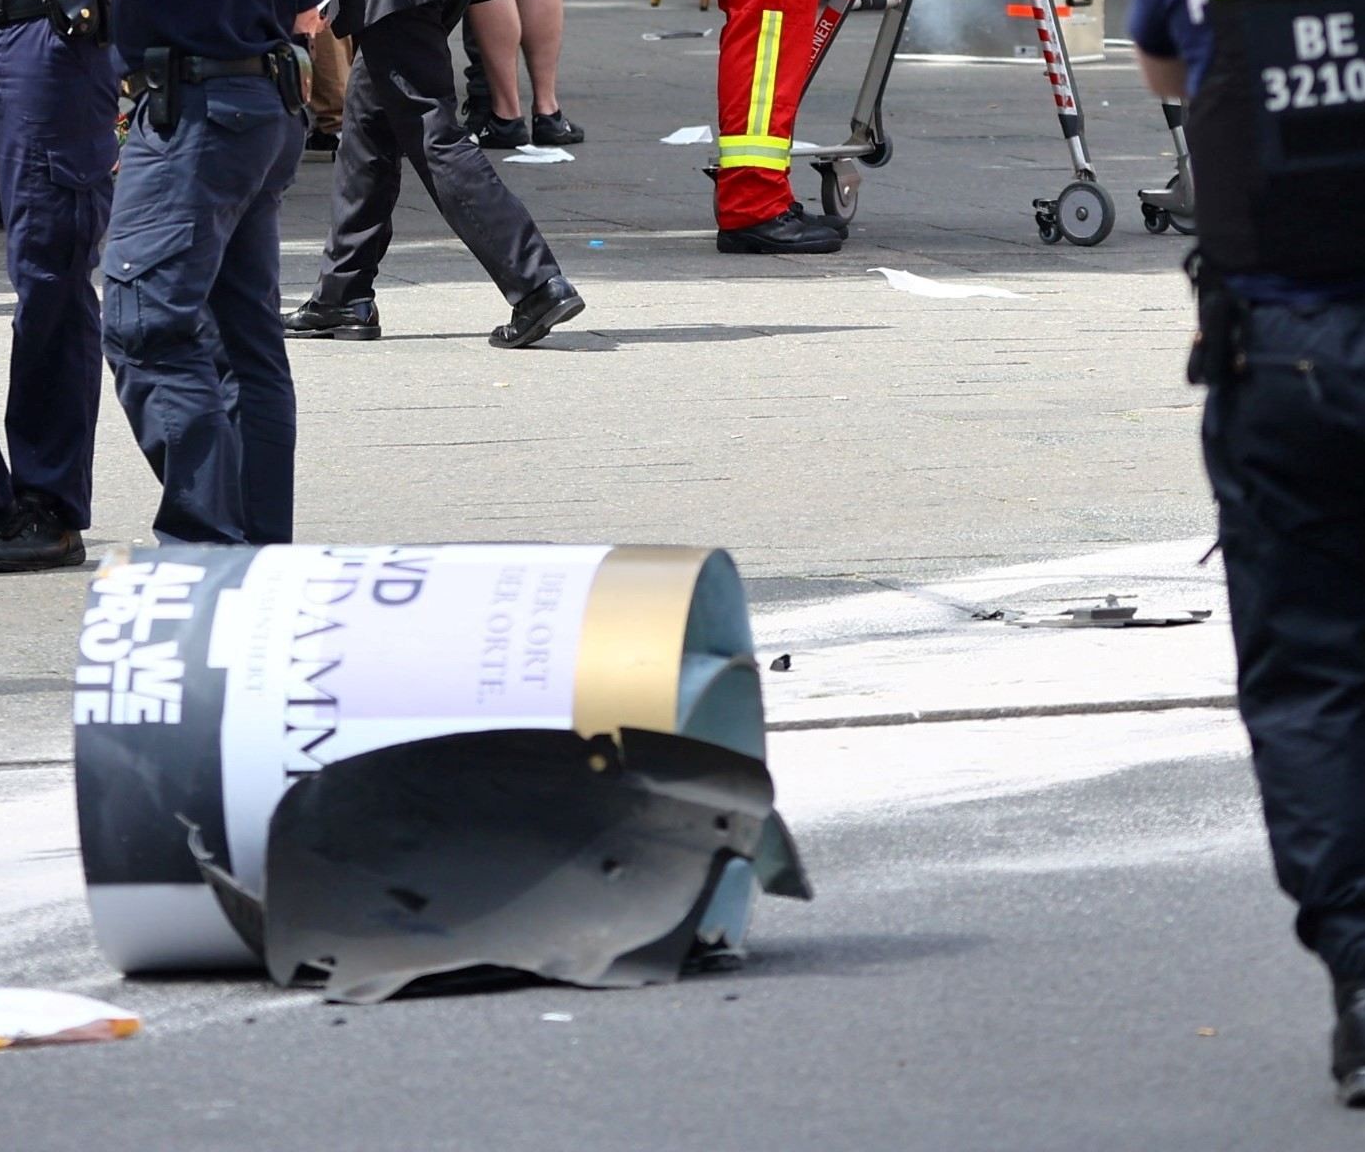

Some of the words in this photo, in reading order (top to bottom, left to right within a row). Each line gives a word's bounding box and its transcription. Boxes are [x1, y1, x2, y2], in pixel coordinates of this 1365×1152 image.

[1294, 12, 1357, 60] BE
[125, 641, 185, 725] WE
[521, 622, 555, 692] ORT
